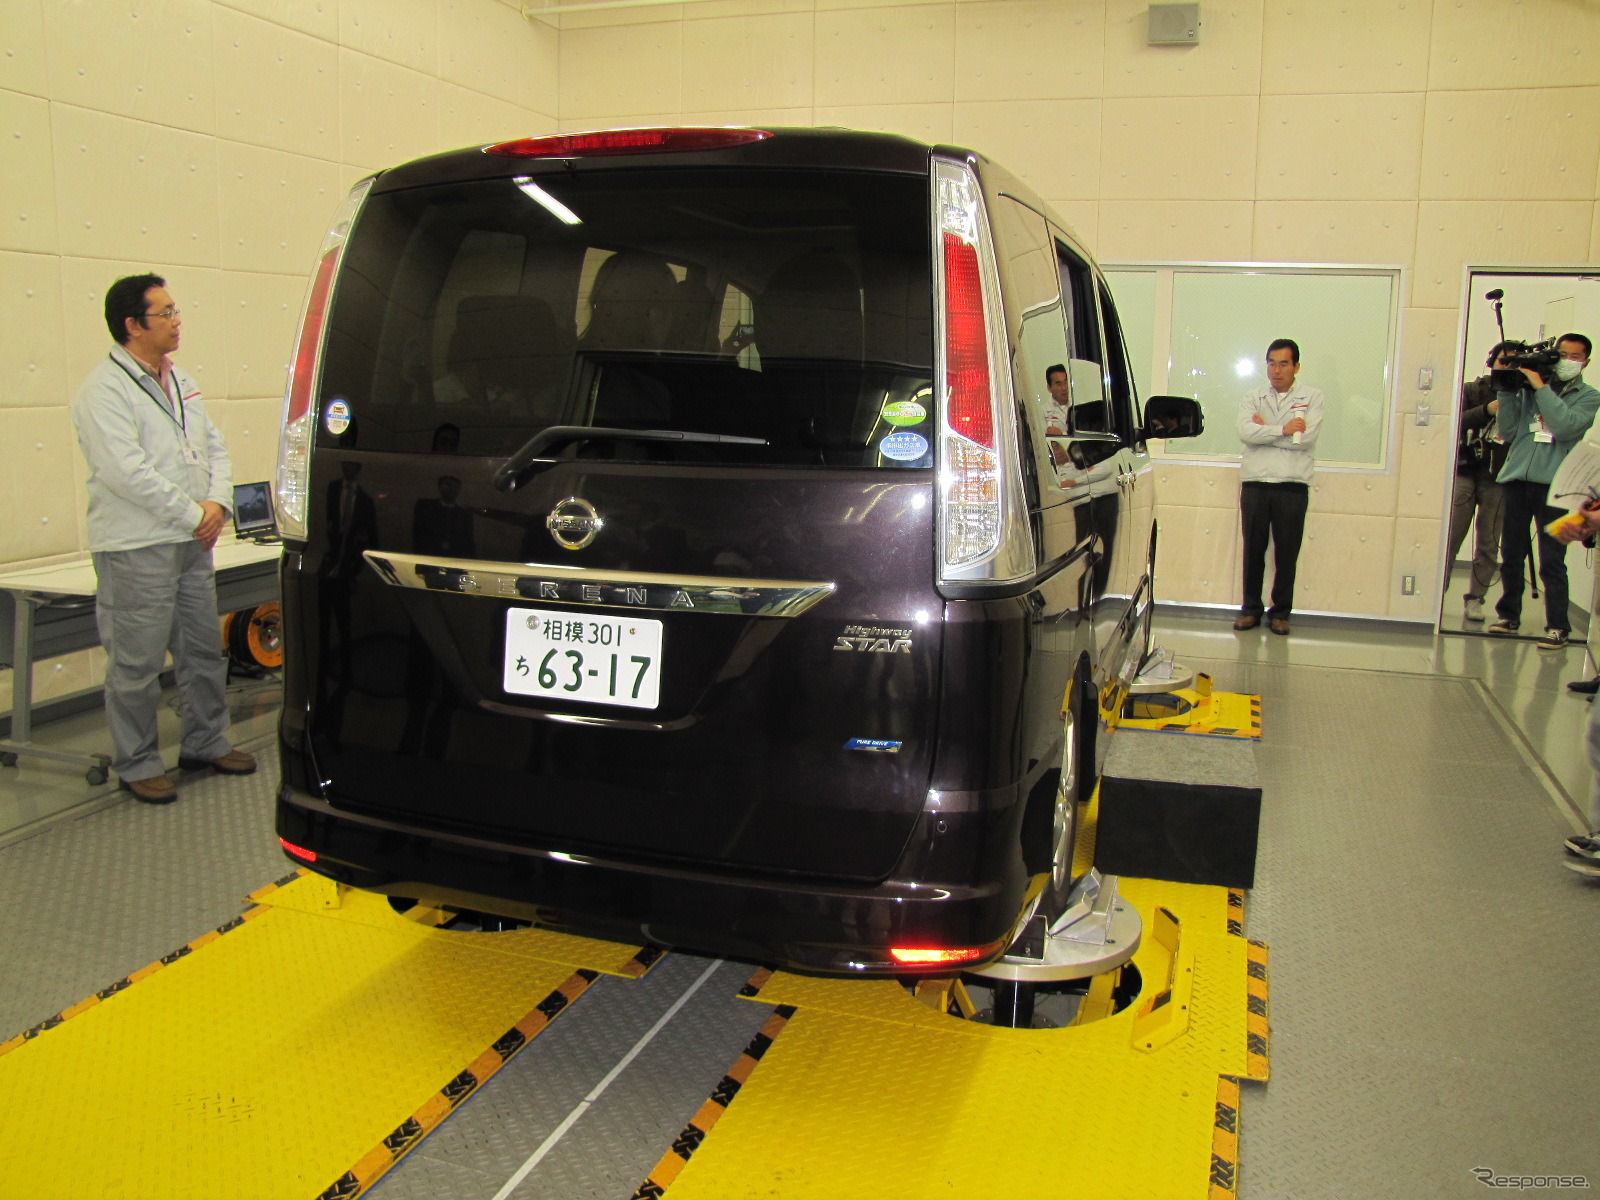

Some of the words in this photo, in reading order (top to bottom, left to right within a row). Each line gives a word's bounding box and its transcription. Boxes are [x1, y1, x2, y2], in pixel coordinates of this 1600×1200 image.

[551, 518, 596, 530] NISSAN
[459, 574, 696, 608] SERENA
[843, 625, 913, 640] Highway
[833, 636, 913, 654] STAR
[516, 655, 531, 677] ち
[538, 648, 652, 699] 63-17
